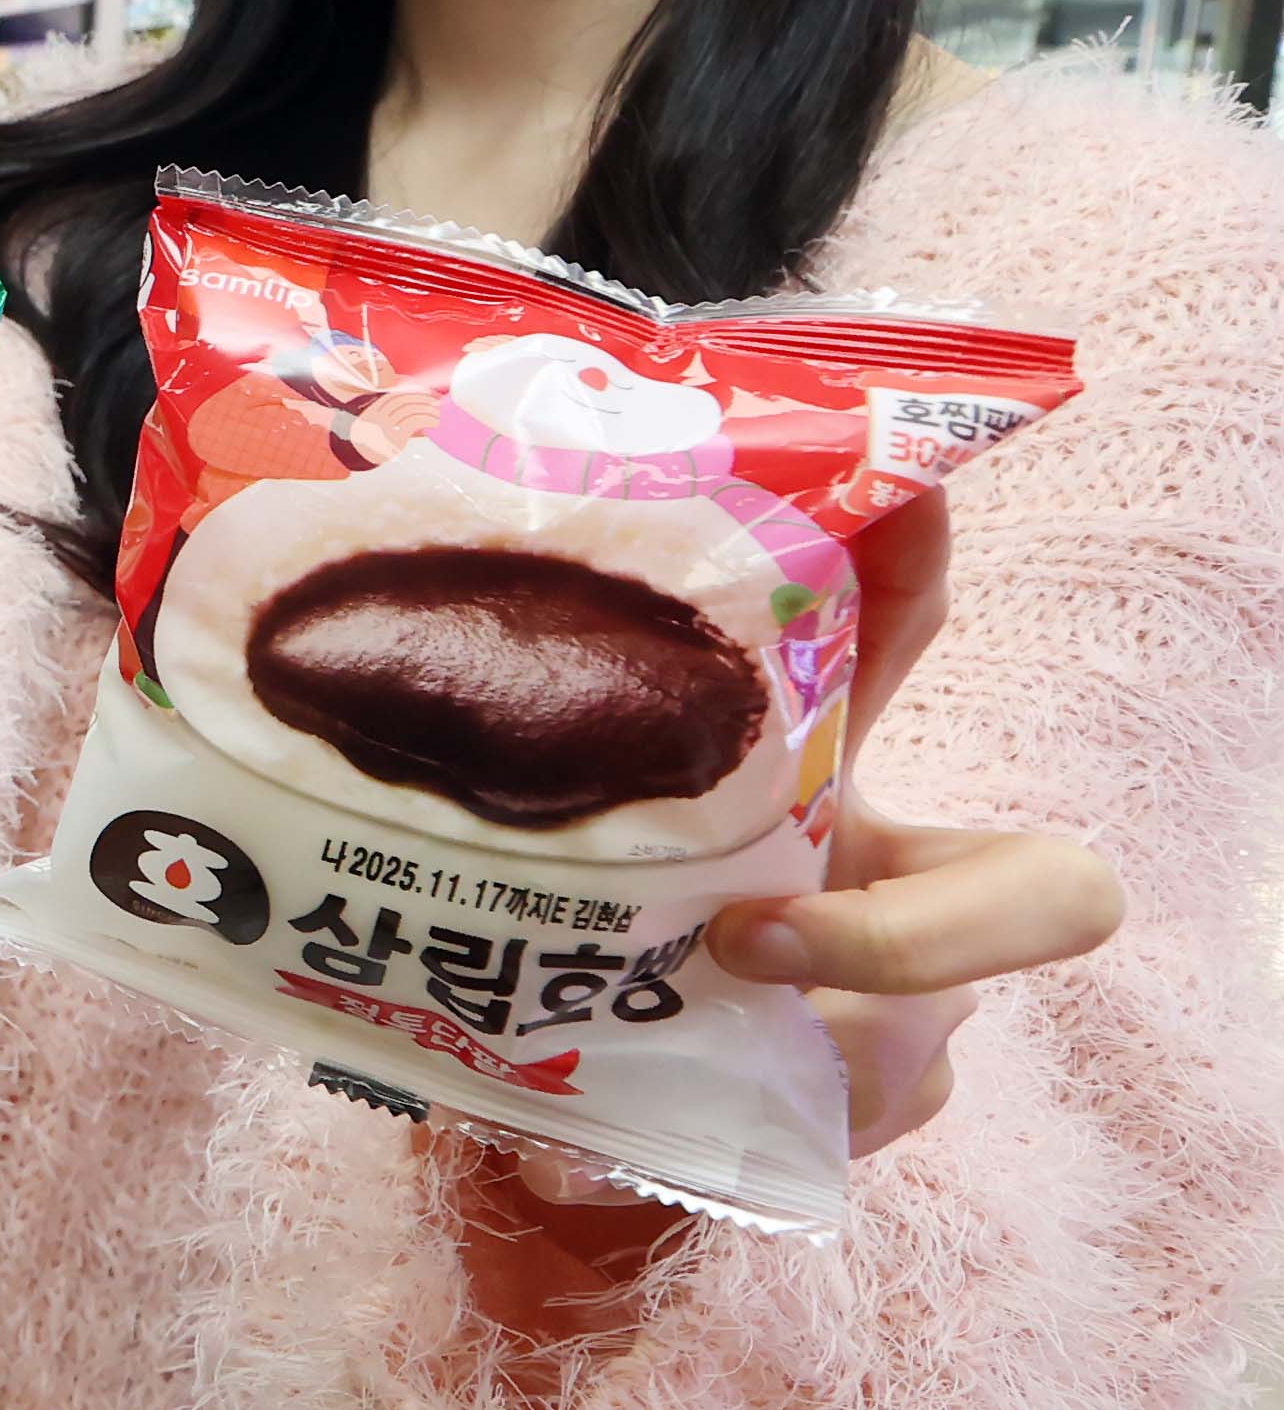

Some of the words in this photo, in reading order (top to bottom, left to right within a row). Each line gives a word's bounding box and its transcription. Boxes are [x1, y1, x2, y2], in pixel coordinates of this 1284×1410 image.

[178, 268, 313, 309] samlip
[320, 837, 569, 926] 나2025.11.17까지E
[287, 892, 707, 1035] 삼립호빵
